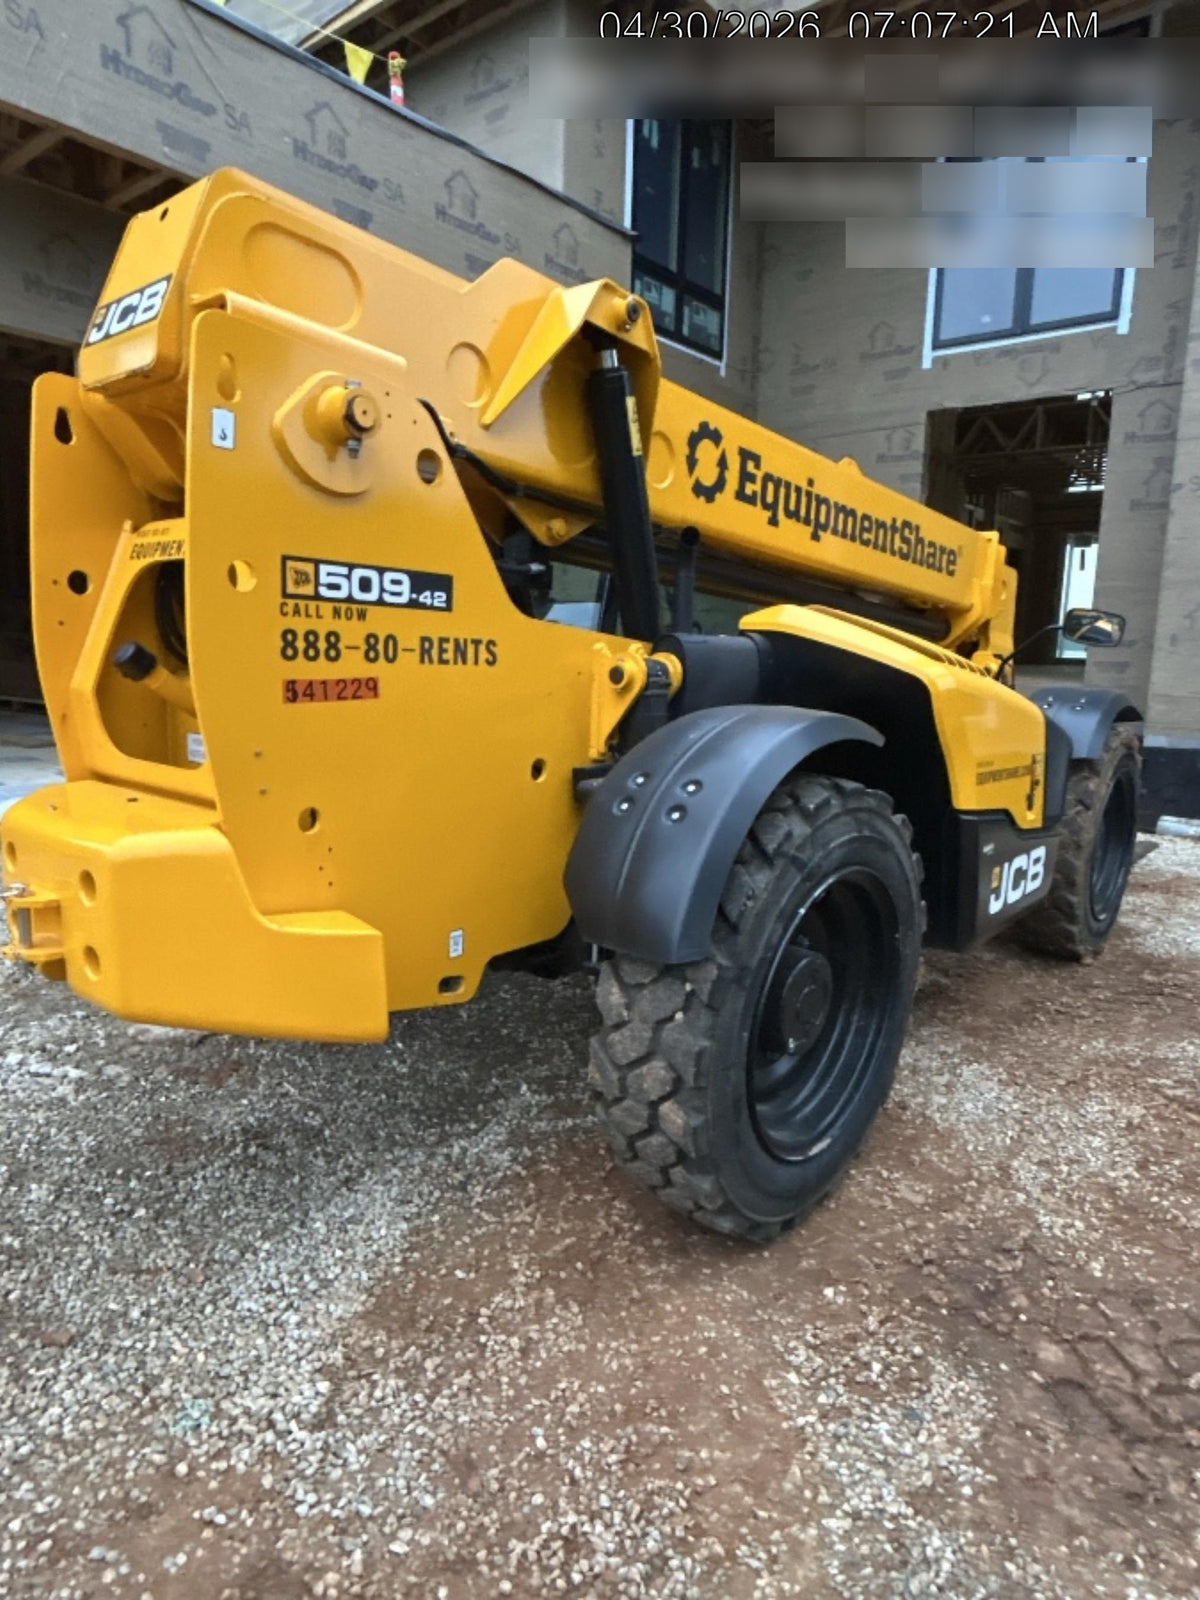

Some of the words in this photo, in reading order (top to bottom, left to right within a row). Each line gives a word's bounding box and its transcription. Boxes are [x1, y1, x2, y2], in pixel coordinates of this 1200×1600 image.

[87, 279, 169, 344] JCB
[735, 446, 958, 577] EquipmentShare
[279, 602, 324, 619] CALL
[332, 605, 369, 622] NOW
[280, 628, 498, 668] 888-80-RENTS
[988, 845, 1047, 916] JCB
